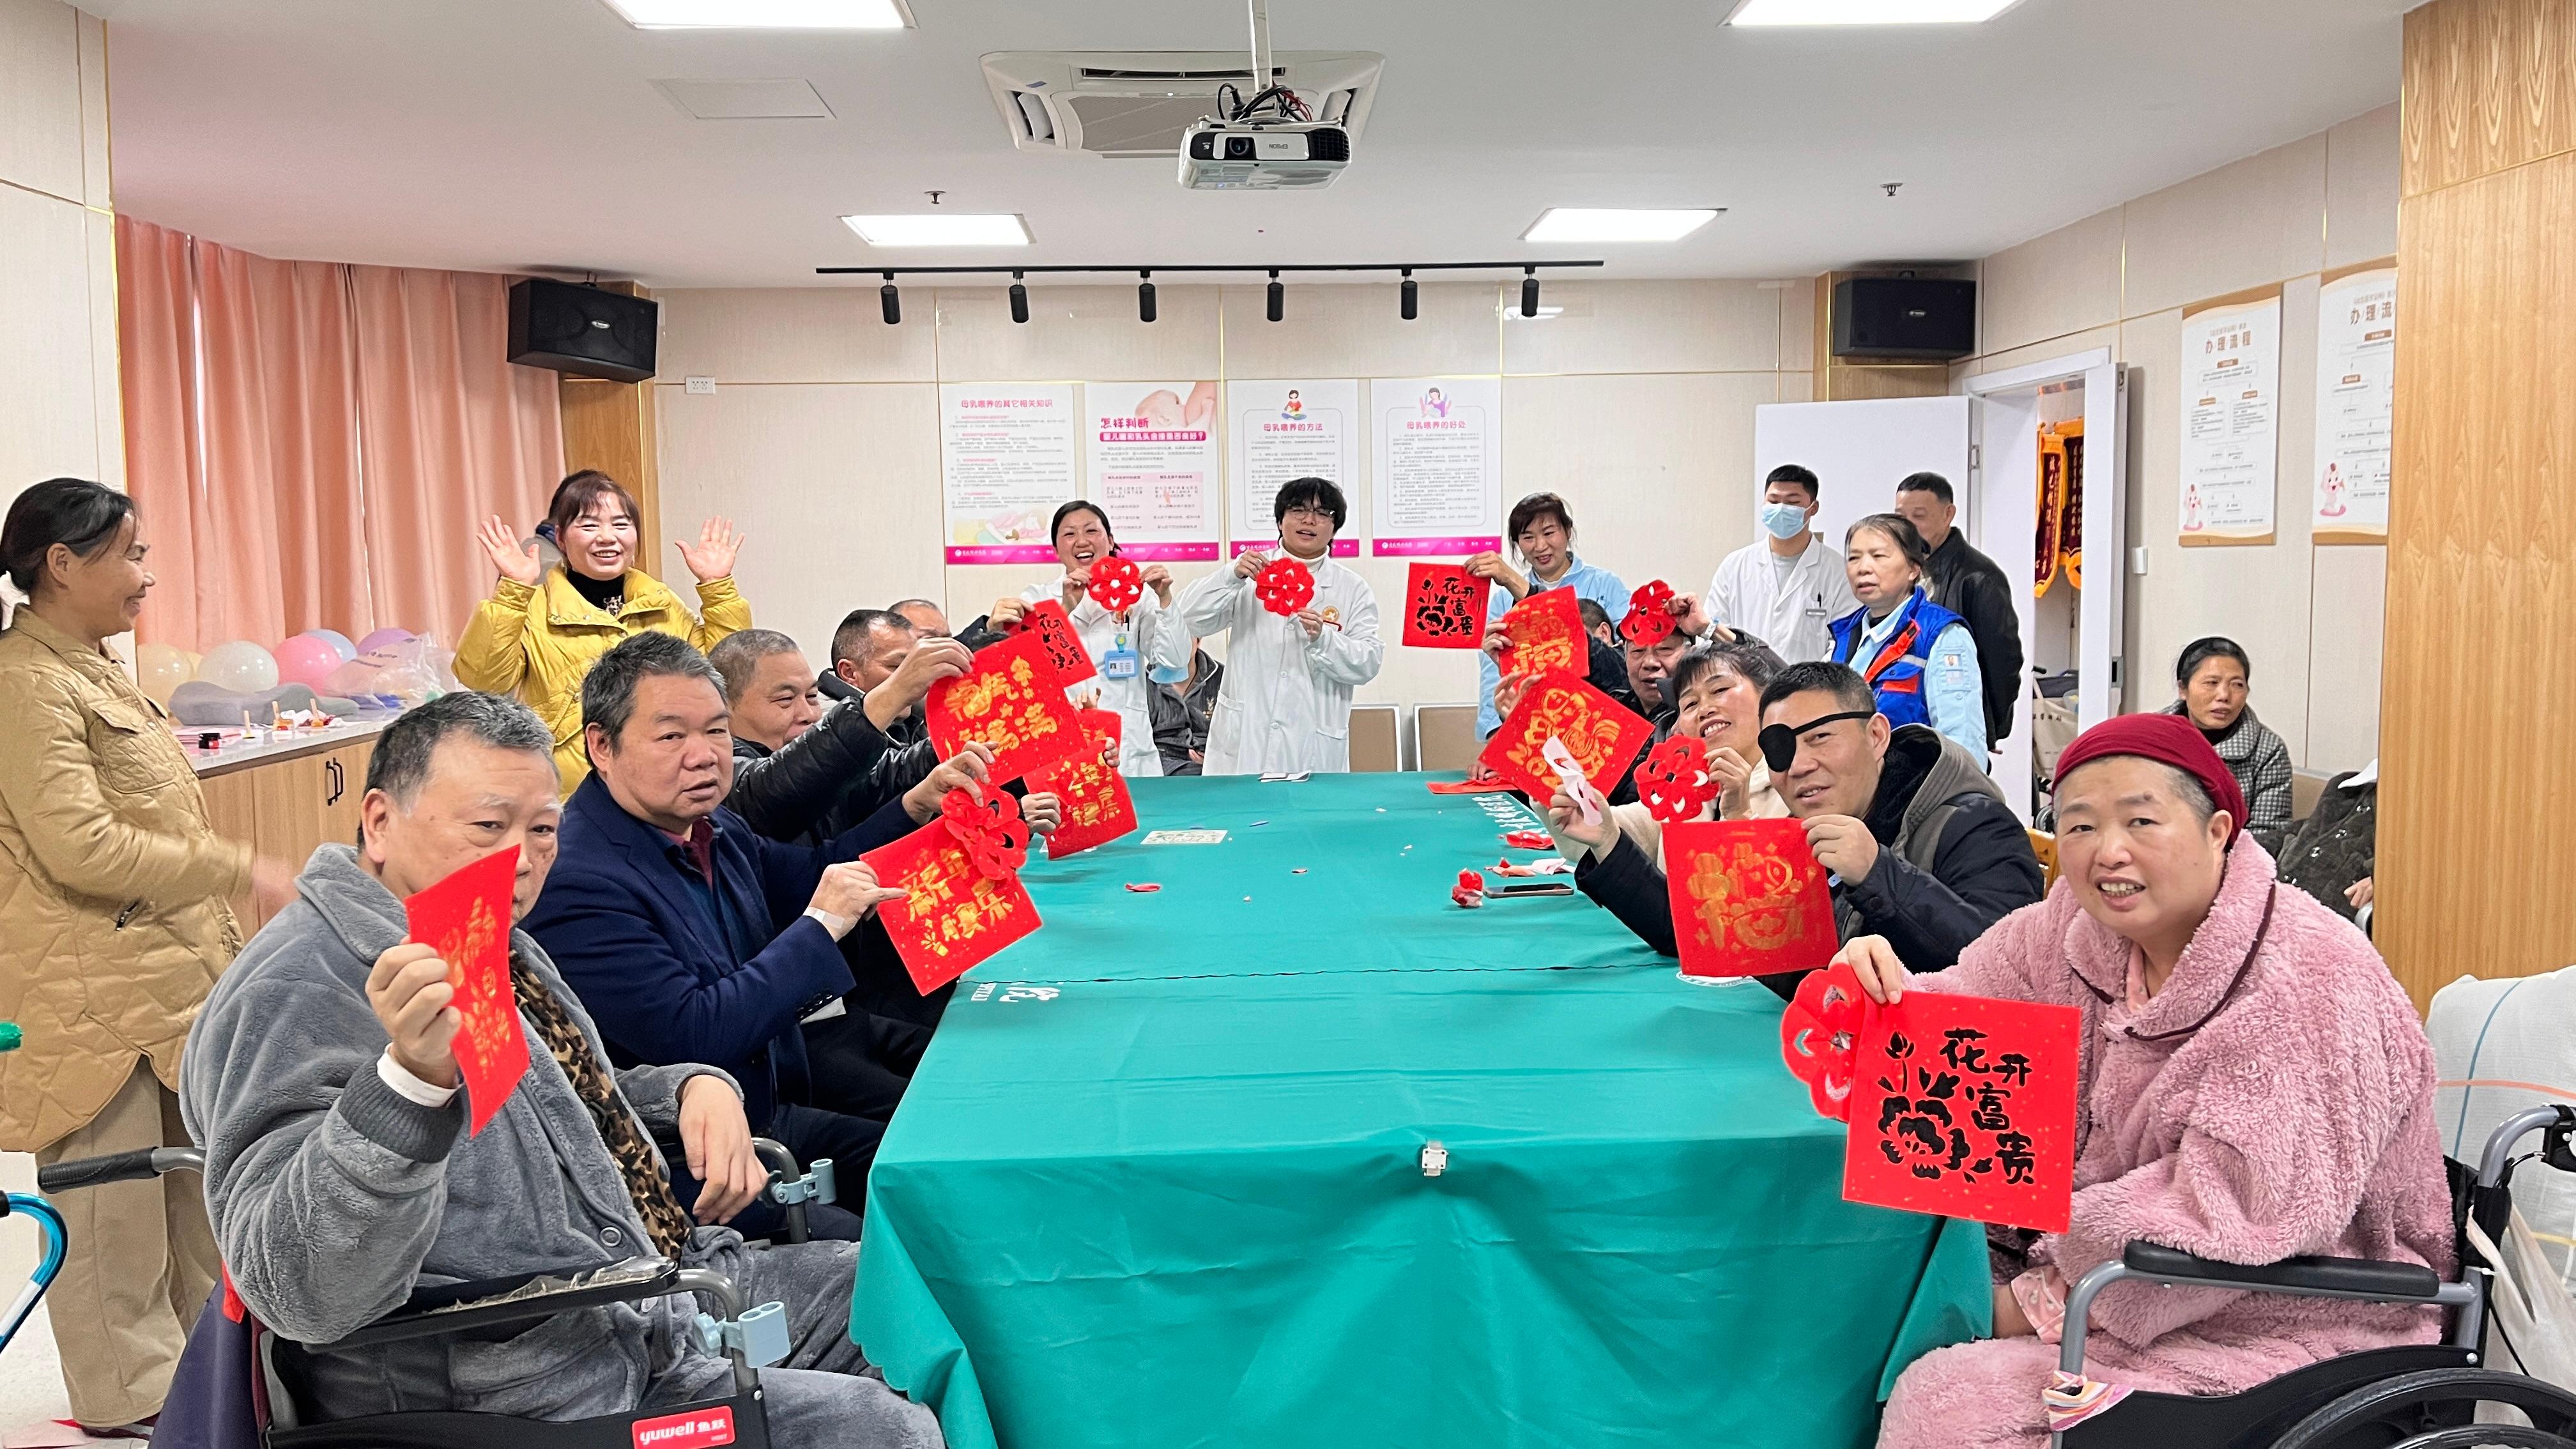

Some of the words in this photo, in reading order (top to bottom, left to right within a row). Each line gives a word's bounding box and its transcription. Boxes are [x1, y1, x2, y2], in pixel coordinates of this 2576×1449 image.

[961, 399, 1053, 408] 母乳喂养的其它相关知识
[1100, 417, 1149, 429] 怎样判断
[1407, 420, 1466, 429] 母乳喂养的好处
[640, 1421, 695, 1446] yuwell
